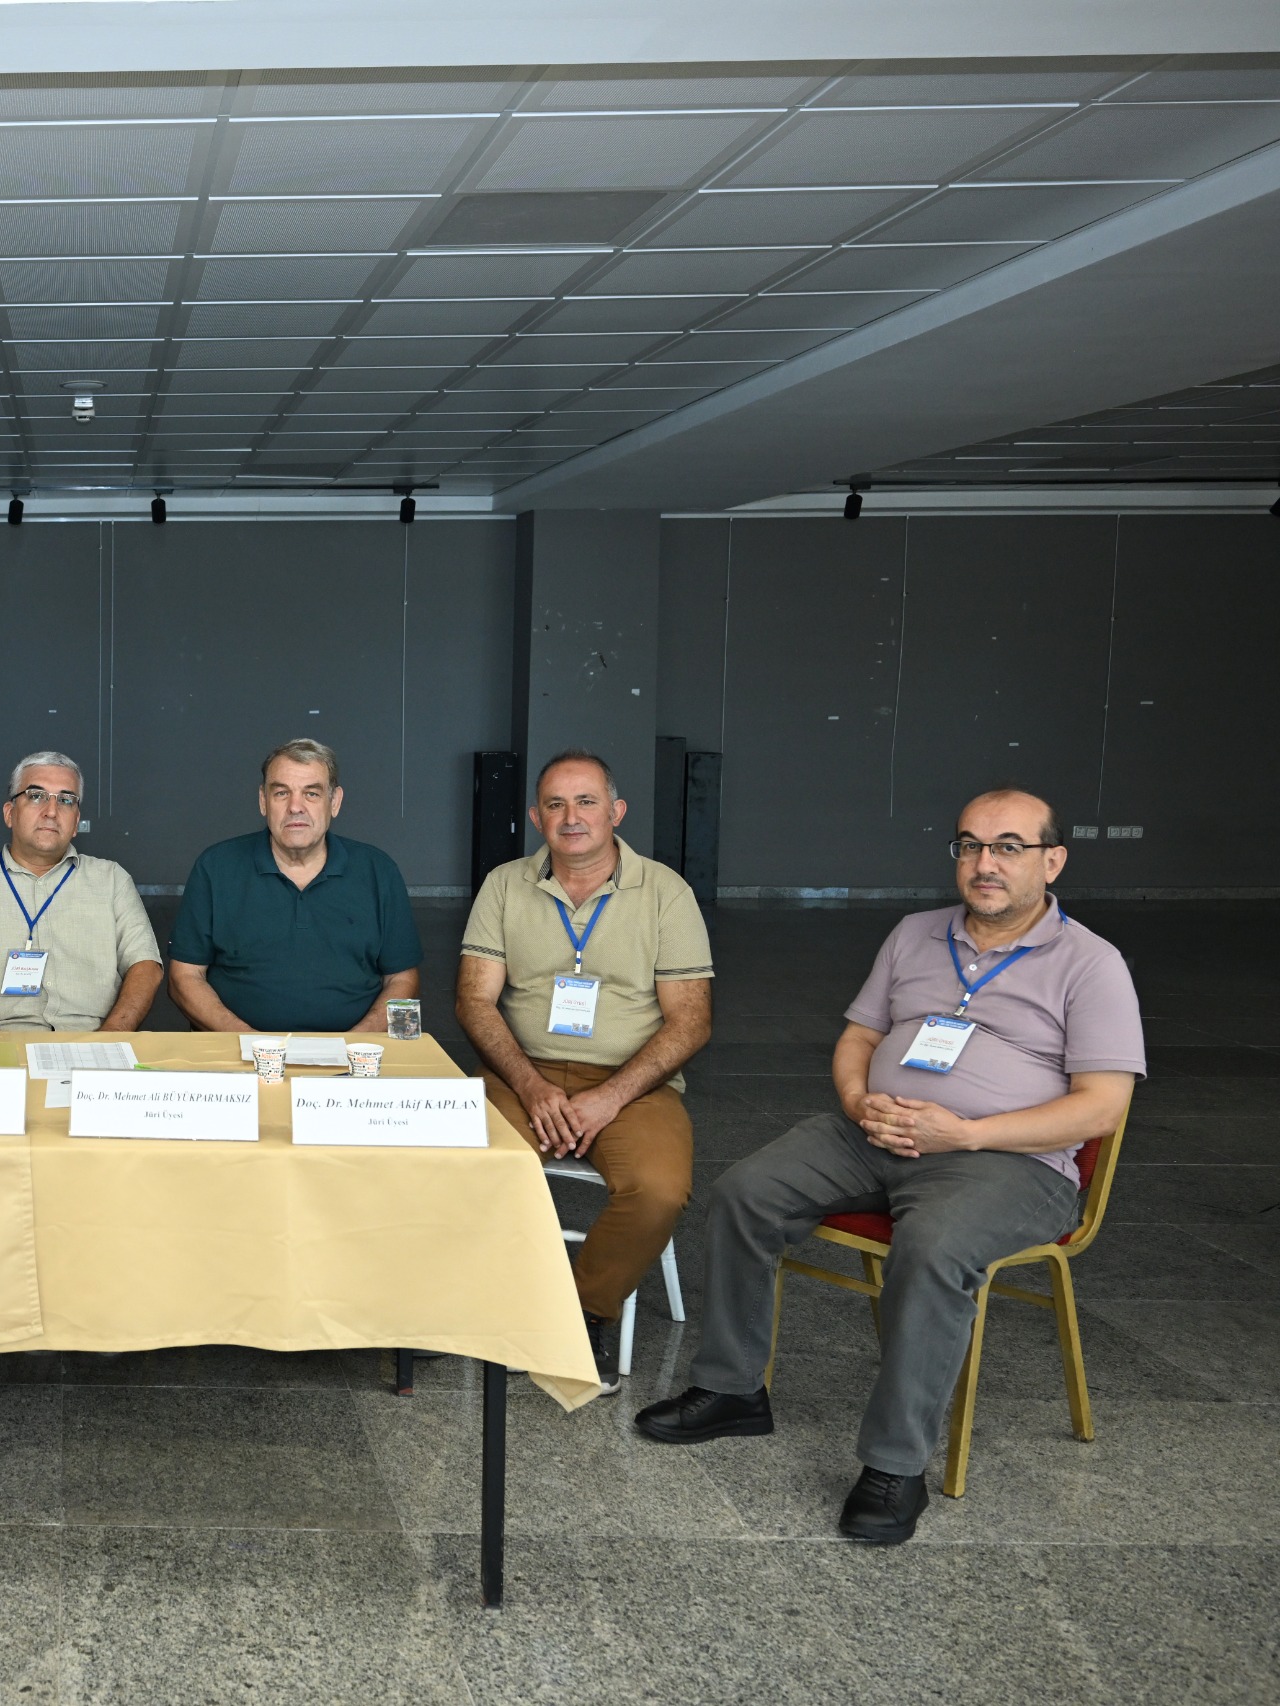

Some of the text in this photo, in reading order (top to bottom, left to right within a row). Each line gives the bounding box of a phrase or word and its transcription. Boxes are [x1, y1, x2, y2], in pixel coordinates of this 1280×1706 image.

[77, 1090, 252, 1103] Doç. Dr. Mehmet Ali BÜYÜKPARMAKSIZ
[296, 1098, 479, 1111] Doç. Dr. Mehmet Akif KAPLAN
[162, 1110, 183, 1119] Üyesi
[387, 1117, 408, 1127] Üyesi
